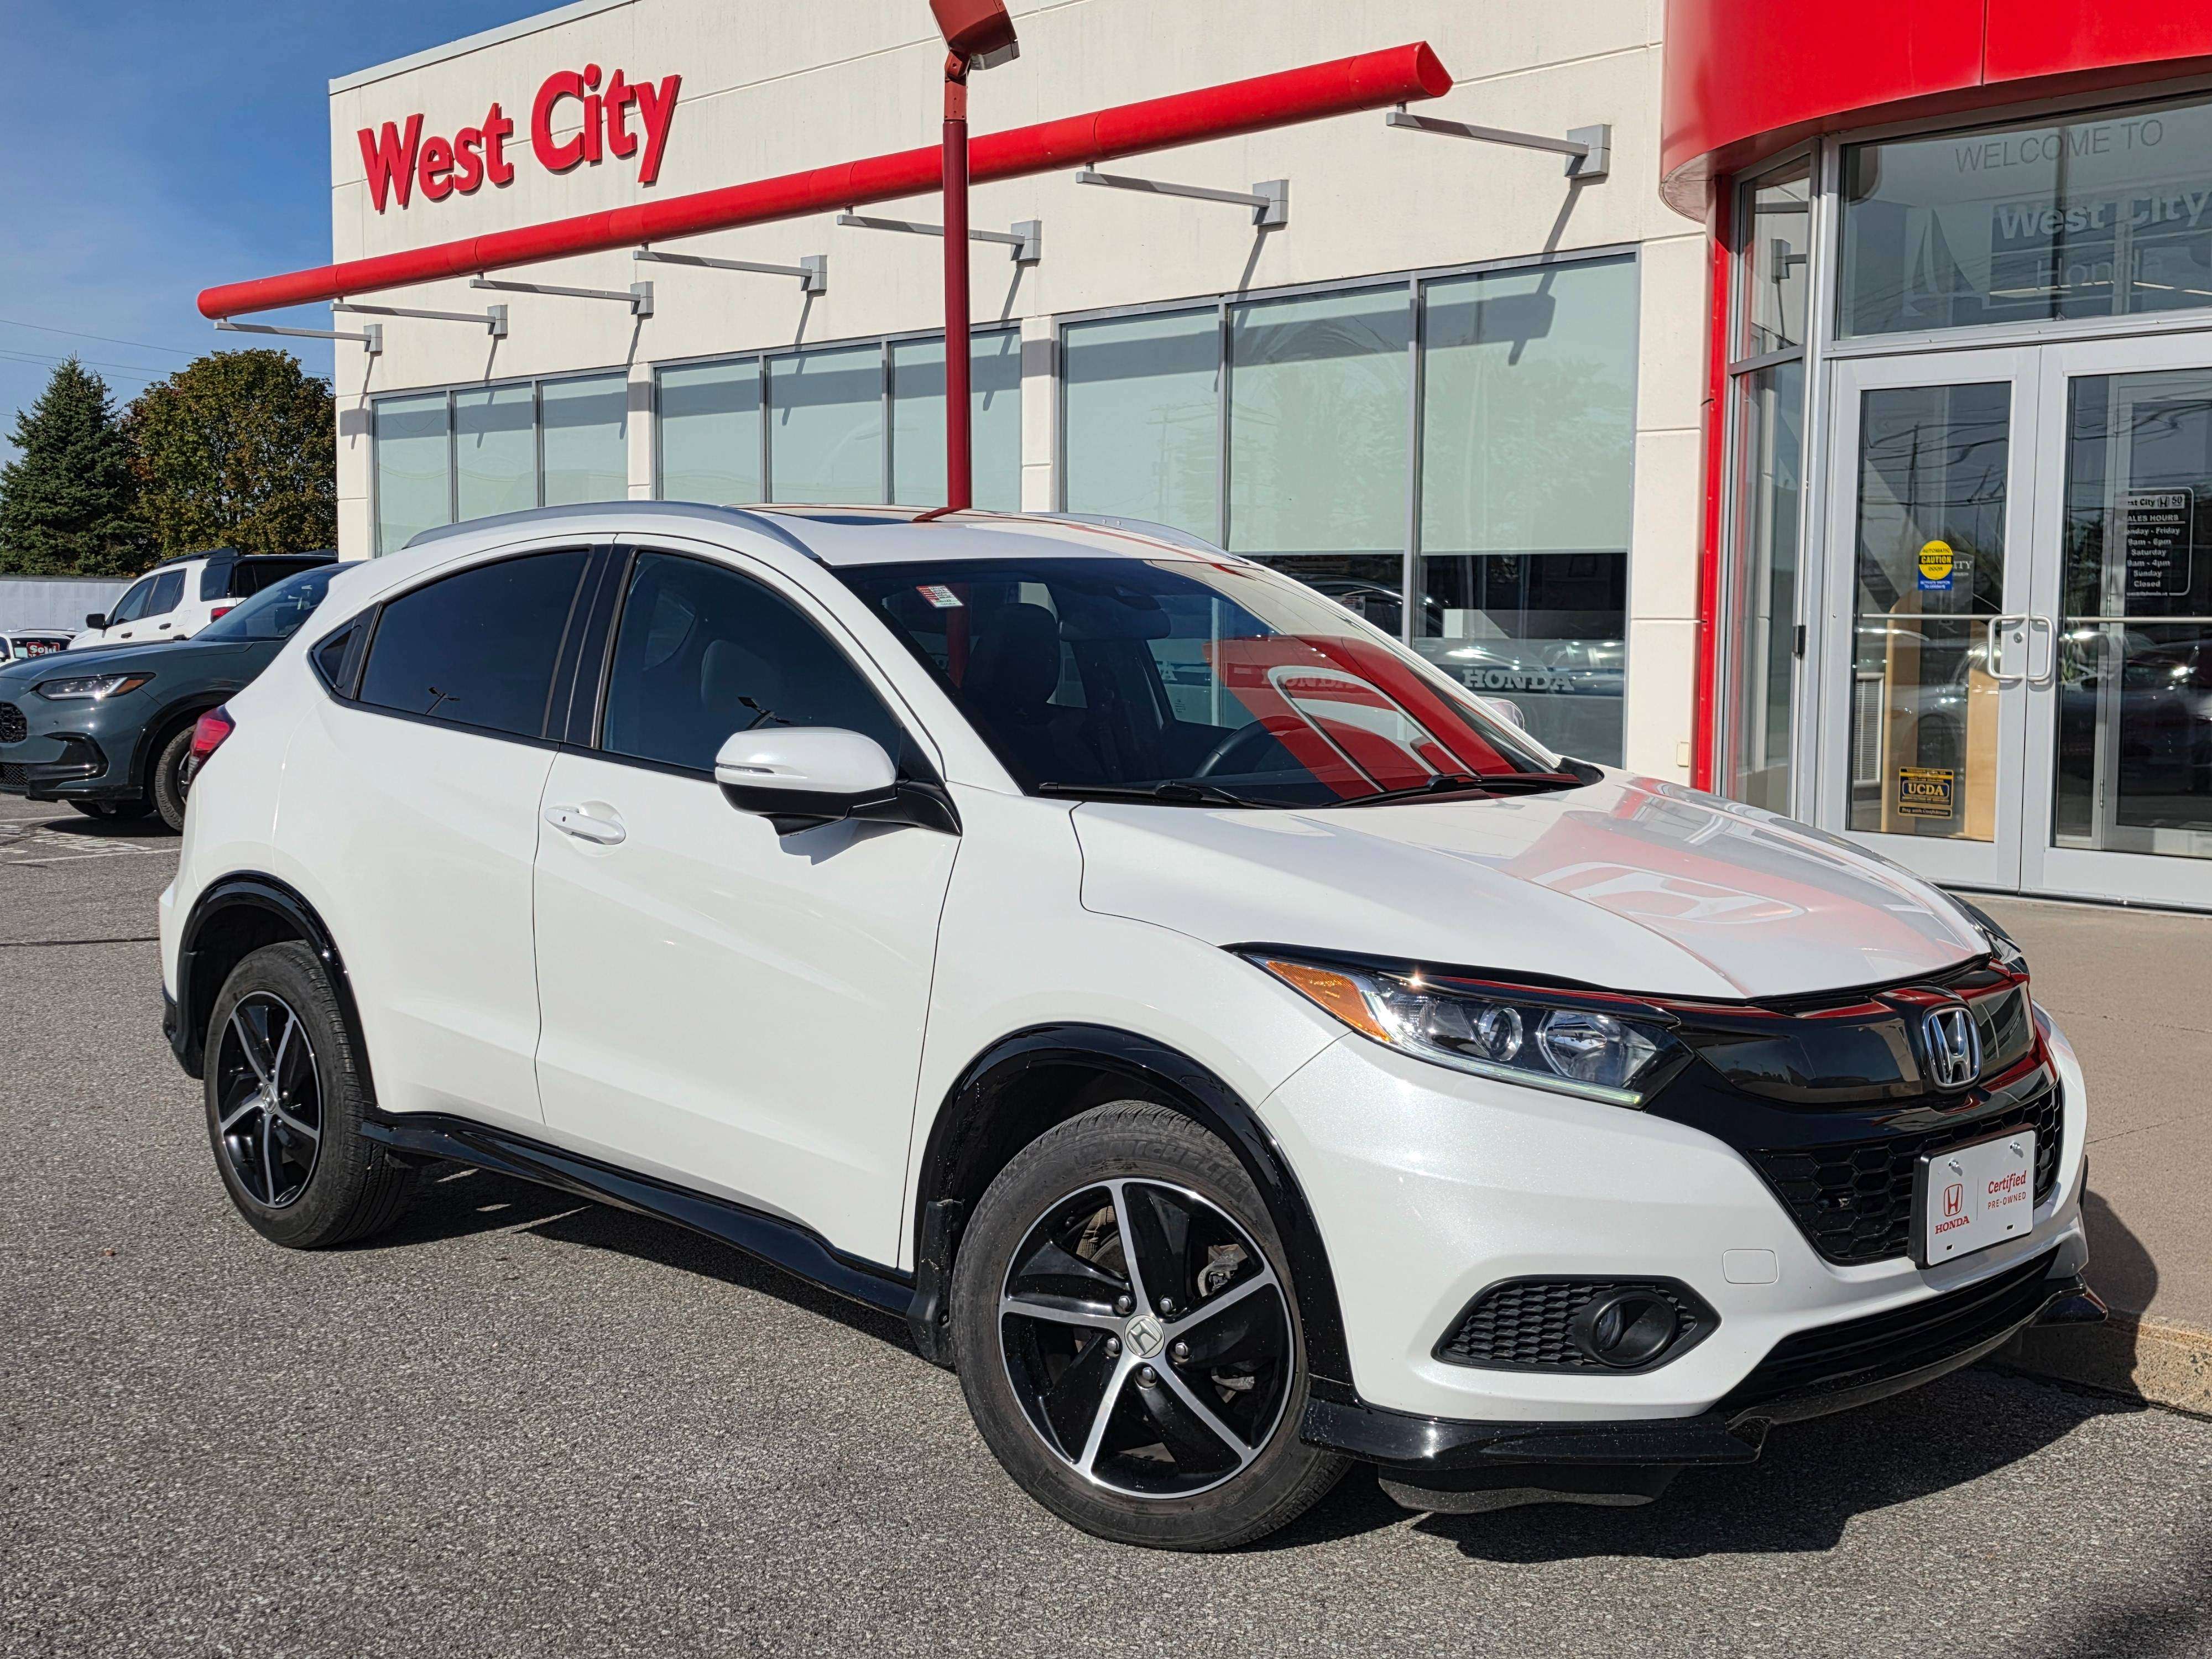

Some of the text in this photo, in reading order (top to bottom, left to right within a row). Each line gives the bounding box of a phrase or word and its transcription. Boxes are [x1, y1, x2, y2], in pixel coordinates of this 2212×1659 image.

[357, 64, 681, 213] West City
[1955, 119, 2163, 173] WELCOME TO
[1998, 201, 2105, 239] West
[2140, 498, 2156, 508] City
[2156, 527, 2180, 535] Friday
[2131, 549, 2167, 557] Saturday
[1462, 669, 1575, 691] HONDA
[1908, 783, 1944, 796] UCDA
[1987, 1170, 2027, 1194] Certified
[1987, 1192, 2027, 1210] PRE-OWNED
[1935, 1215, 1970, 1234] HONDA
